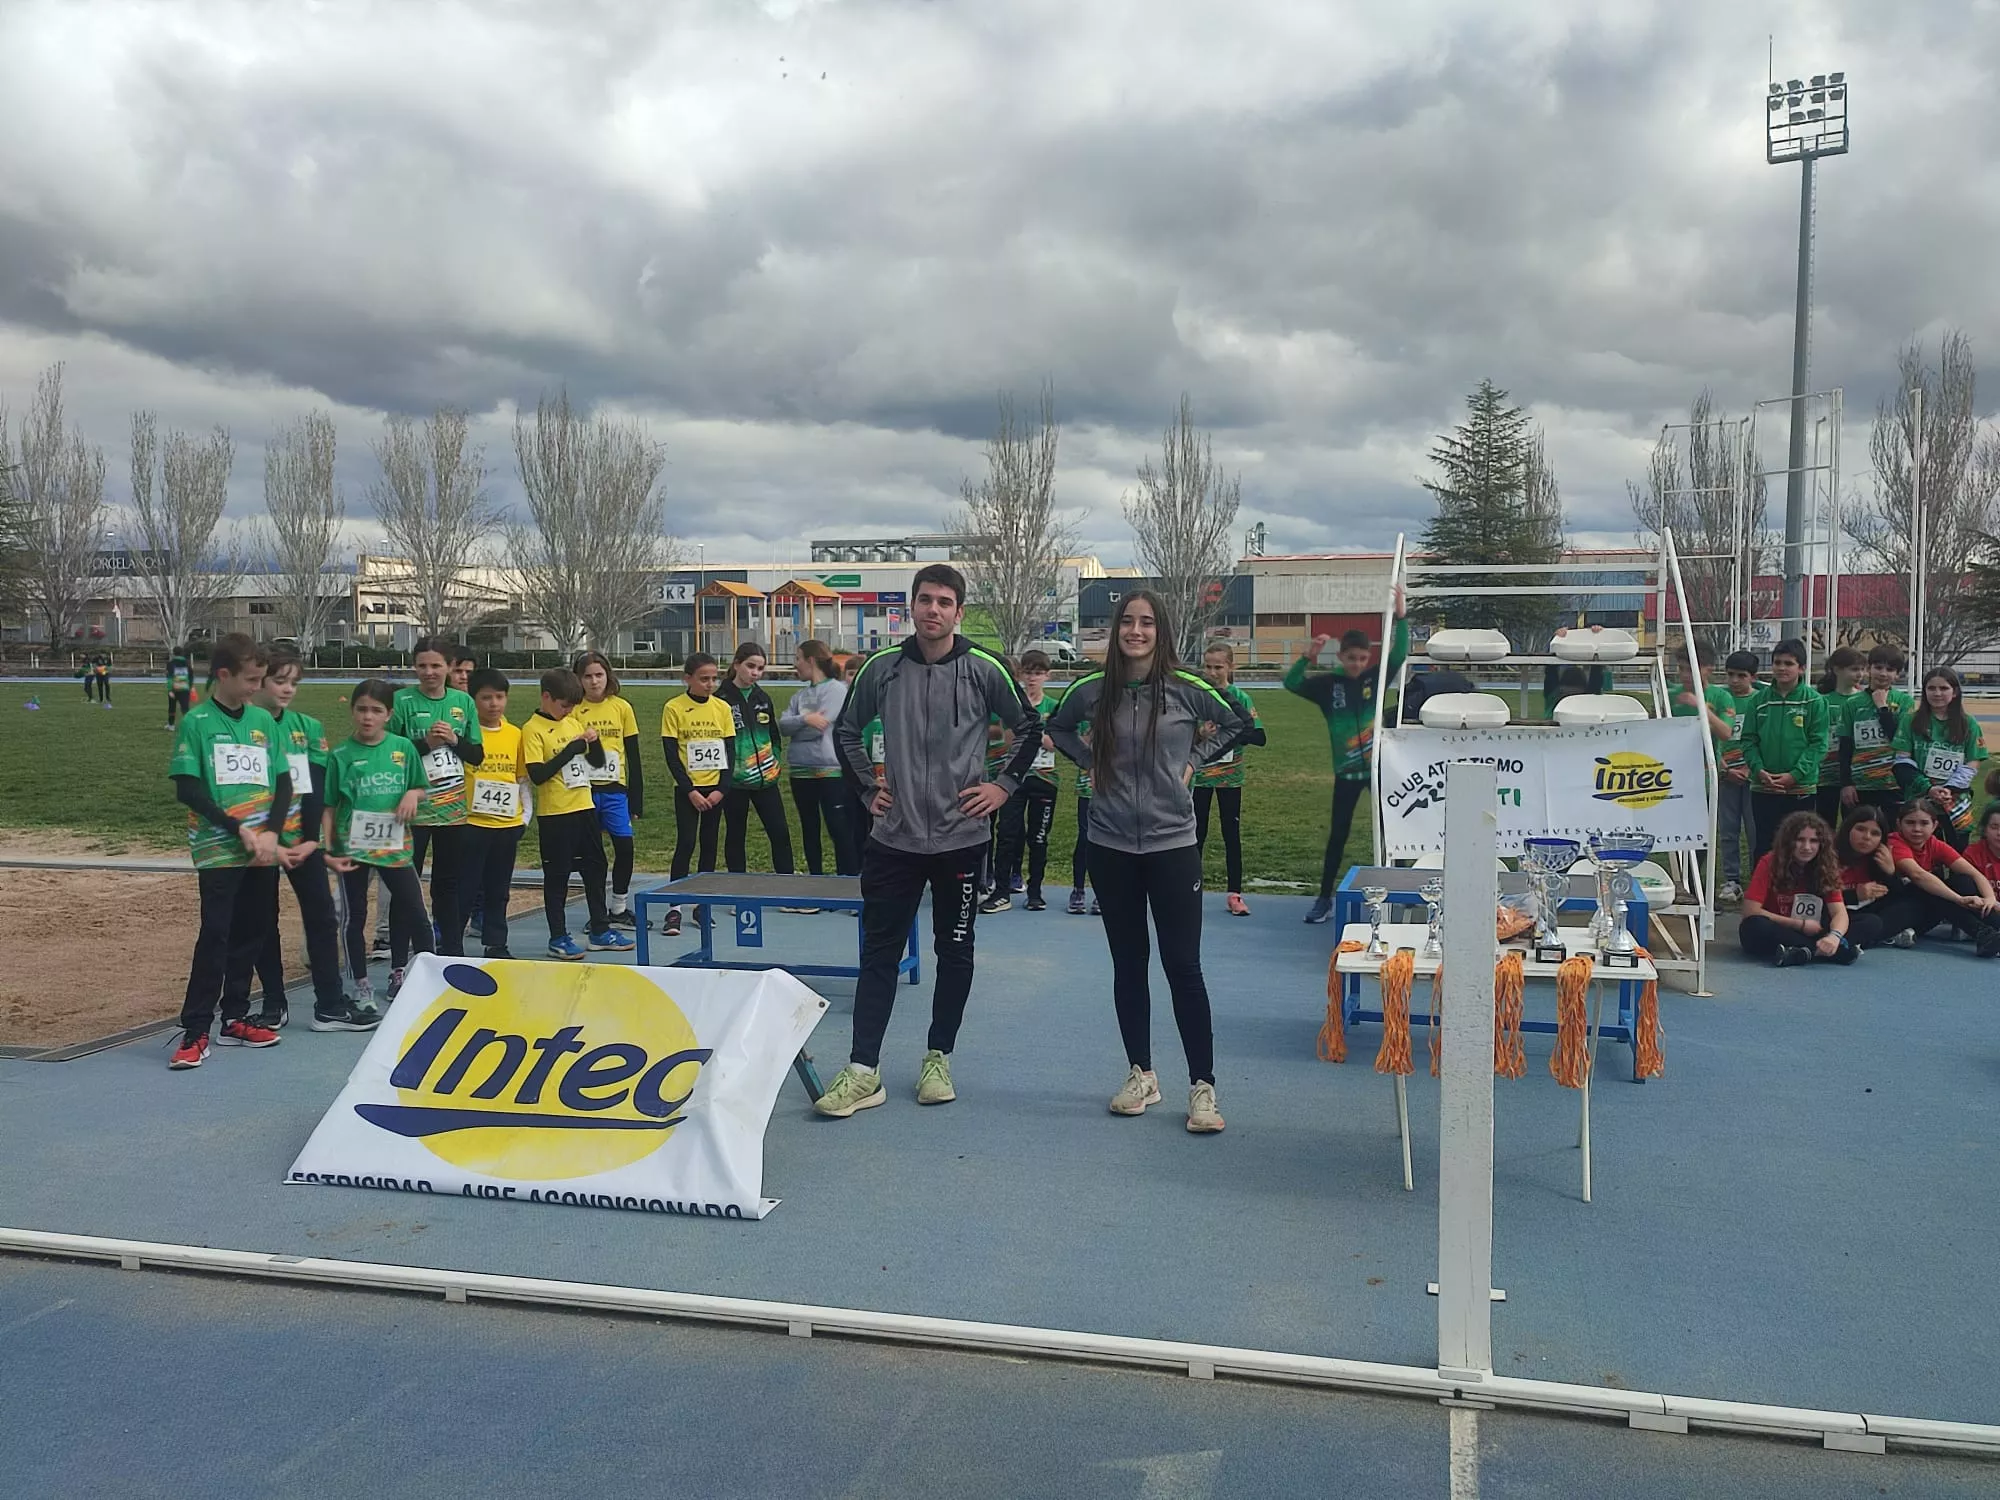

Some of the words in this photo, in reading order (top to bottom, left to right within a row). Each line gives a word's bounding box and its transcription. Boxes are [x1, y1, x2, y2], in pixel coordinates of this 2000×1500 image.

[226, 754, 262, 773] 506
[694, 748, 721, 762] 542
[481, 789, 511, 806] 442
[1387, 772, 1424, 808] CLUB
[364, 822, 393, 838] 511
[952, 883, 973, 942] Huesca
